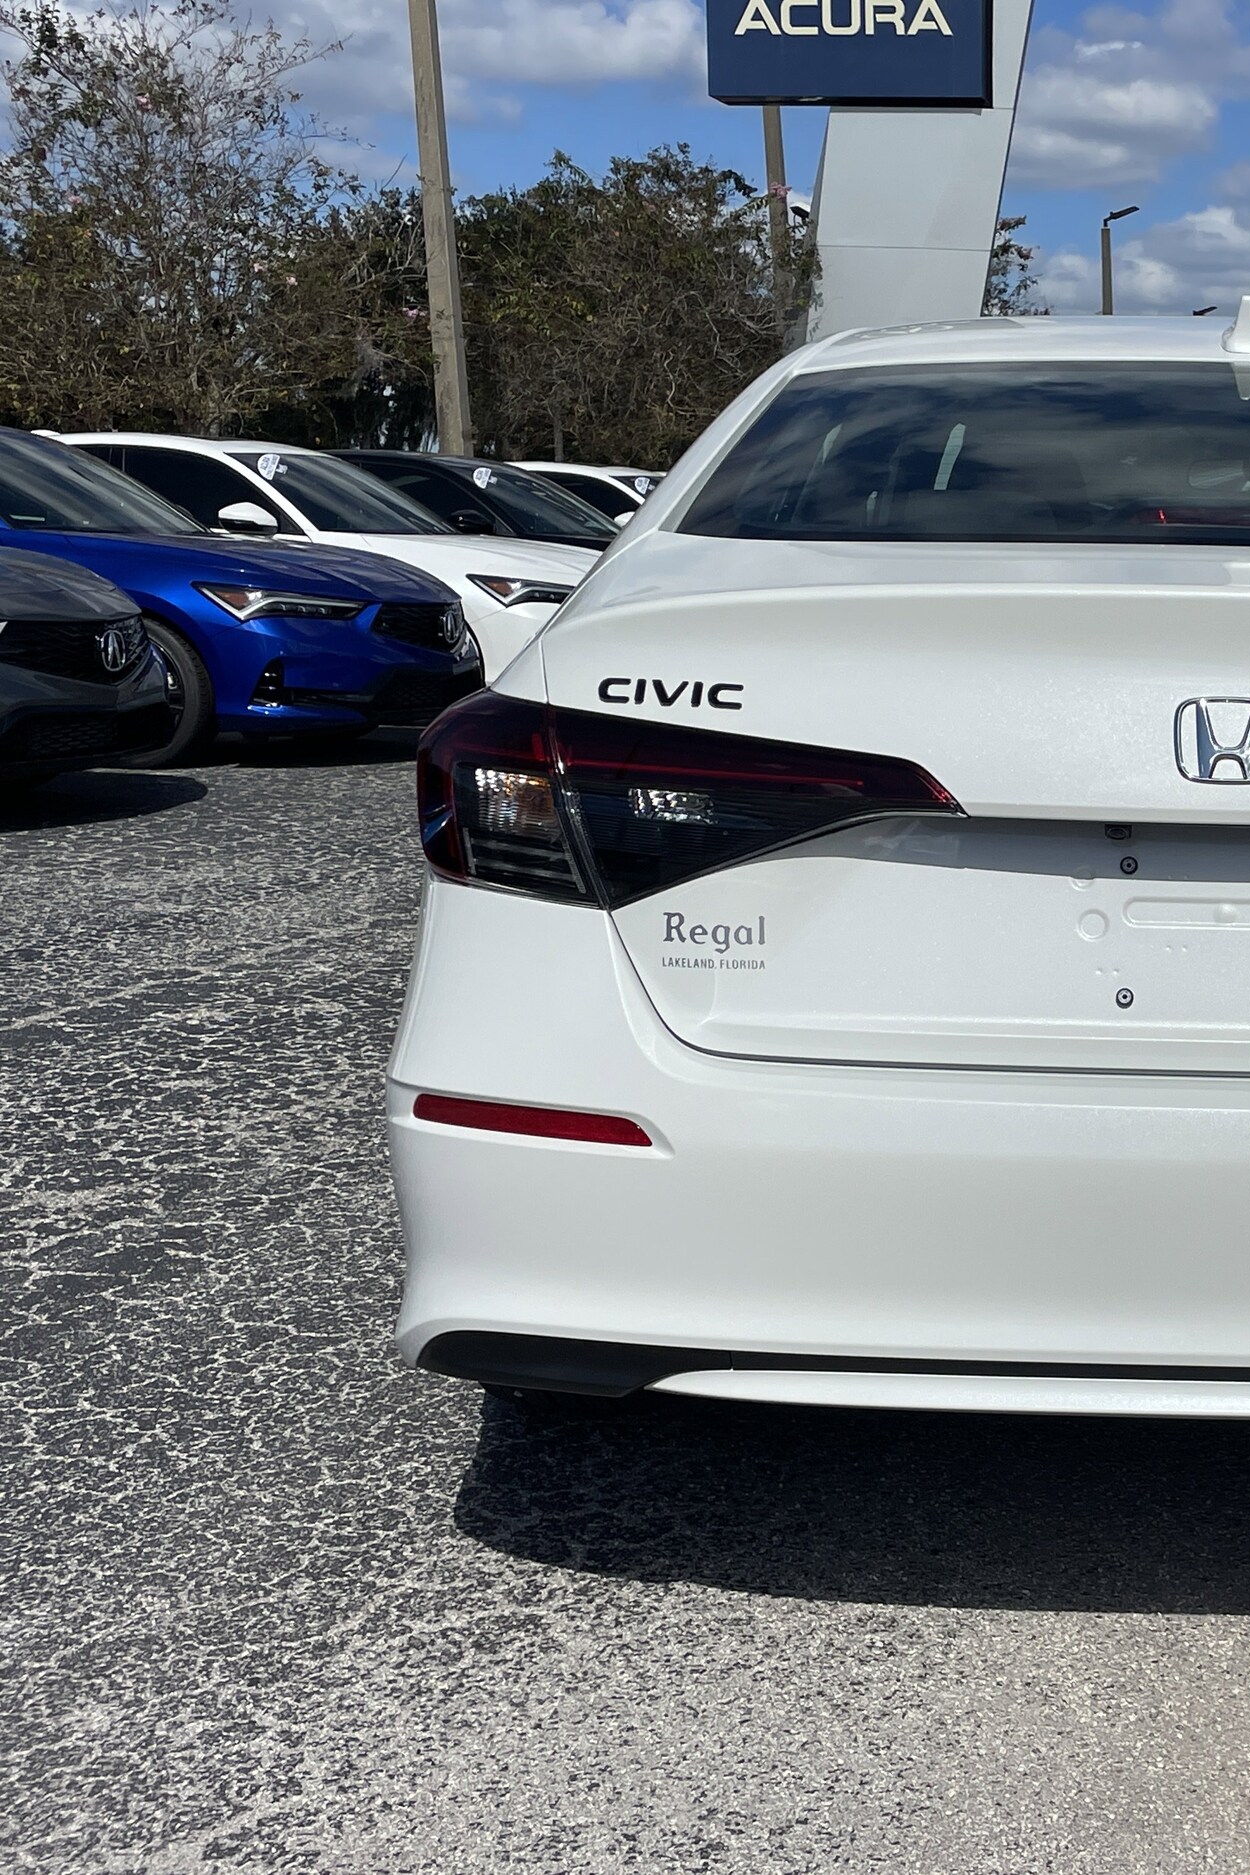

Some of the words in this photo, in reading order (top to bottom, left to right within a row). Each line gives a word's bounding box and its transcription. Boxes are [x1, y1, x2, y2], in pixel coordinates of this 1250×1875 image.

[734, 0, 954, 36] ACURA
[598, 677, 744, 711] CIVIC
[662, 911, 766, 954] Regal
[719, 958, 766, 970] FLORIDA
